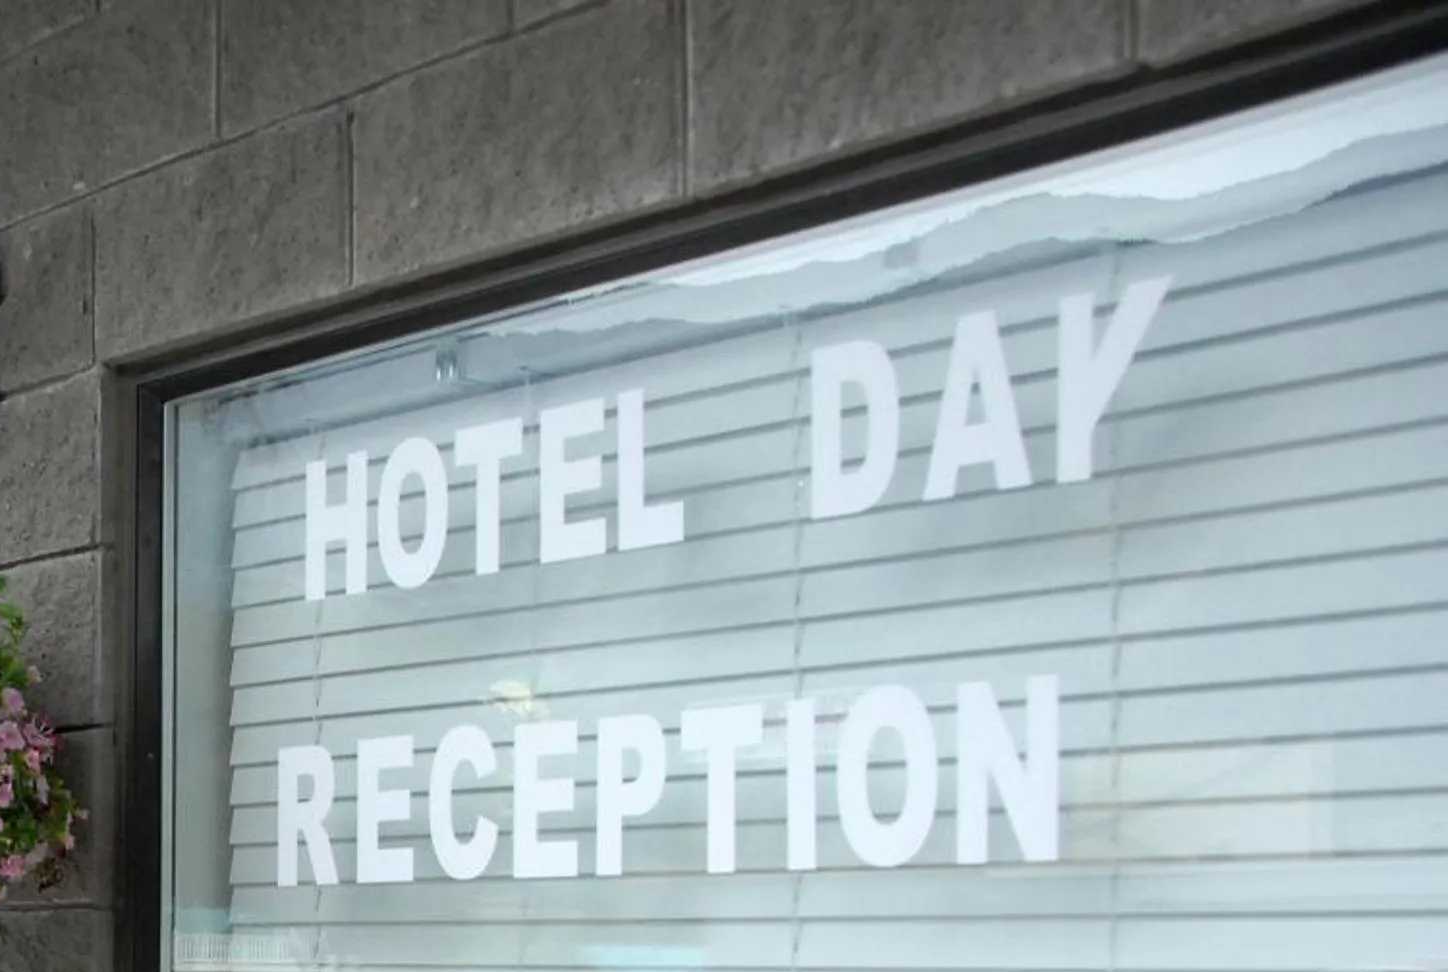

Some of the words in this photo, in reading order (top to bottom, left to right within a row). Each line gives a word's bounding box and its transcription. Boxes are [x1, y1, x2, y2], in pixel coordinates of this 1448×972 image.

[304, 388, 685, 602] HOTEL
[809, 275, 1174, 521] DAY
[276, 674, 1060, 888] RECEPTION
